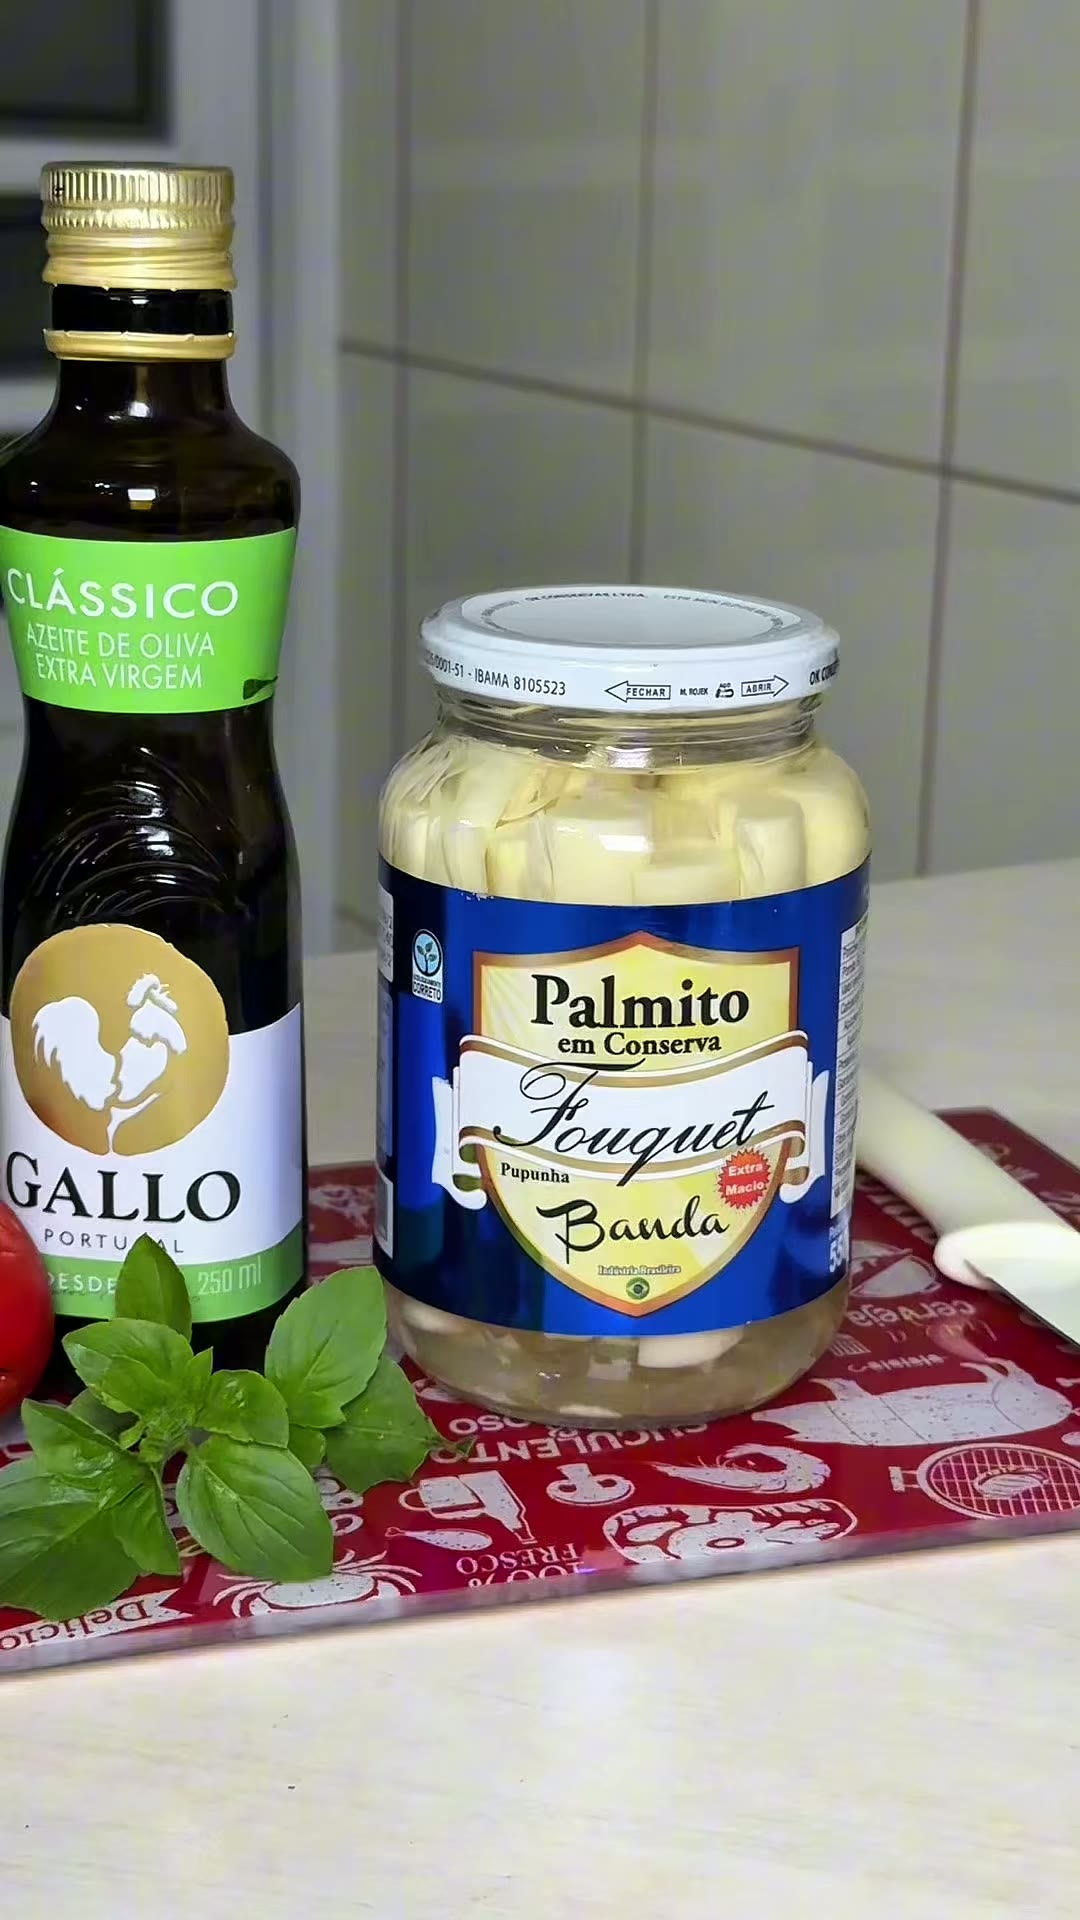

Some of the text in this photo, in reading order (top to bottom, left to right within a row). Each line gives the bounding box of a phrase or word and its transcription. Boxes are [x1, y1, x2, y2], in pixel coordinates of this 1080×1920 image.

[7, 567, 239, 619] CLÁSSICO
[26, 622, 215, 659] AZEITE DE OLIVA
[35, 652, 203, 689] EXTRA VIRGEM
[474, 667, 510, 689] IBAMA
[513, 675, 567, 697] 8105523
[626, 687, 666, 698] FECHAR
[745, 682, 772, 694] ABRIR
[531, 973, 749, 1030] Palmito
[557, 1031, 722, 1056] em Conserva
[494, 1058, 775, 1187] Fouquet
[6, 1150, 242, 1224] GALLO
[500, 1161, 570, 1185] Pupunha
[728, 1164, 763, 1177] Extra
[44, 1228, 184, 1254] PORTUAL
[536, 1195, 731, 1265] Banda
[197, 1256, 262, 1295] 250 ml
[455, 1543, 580, 1575] FRESCO
